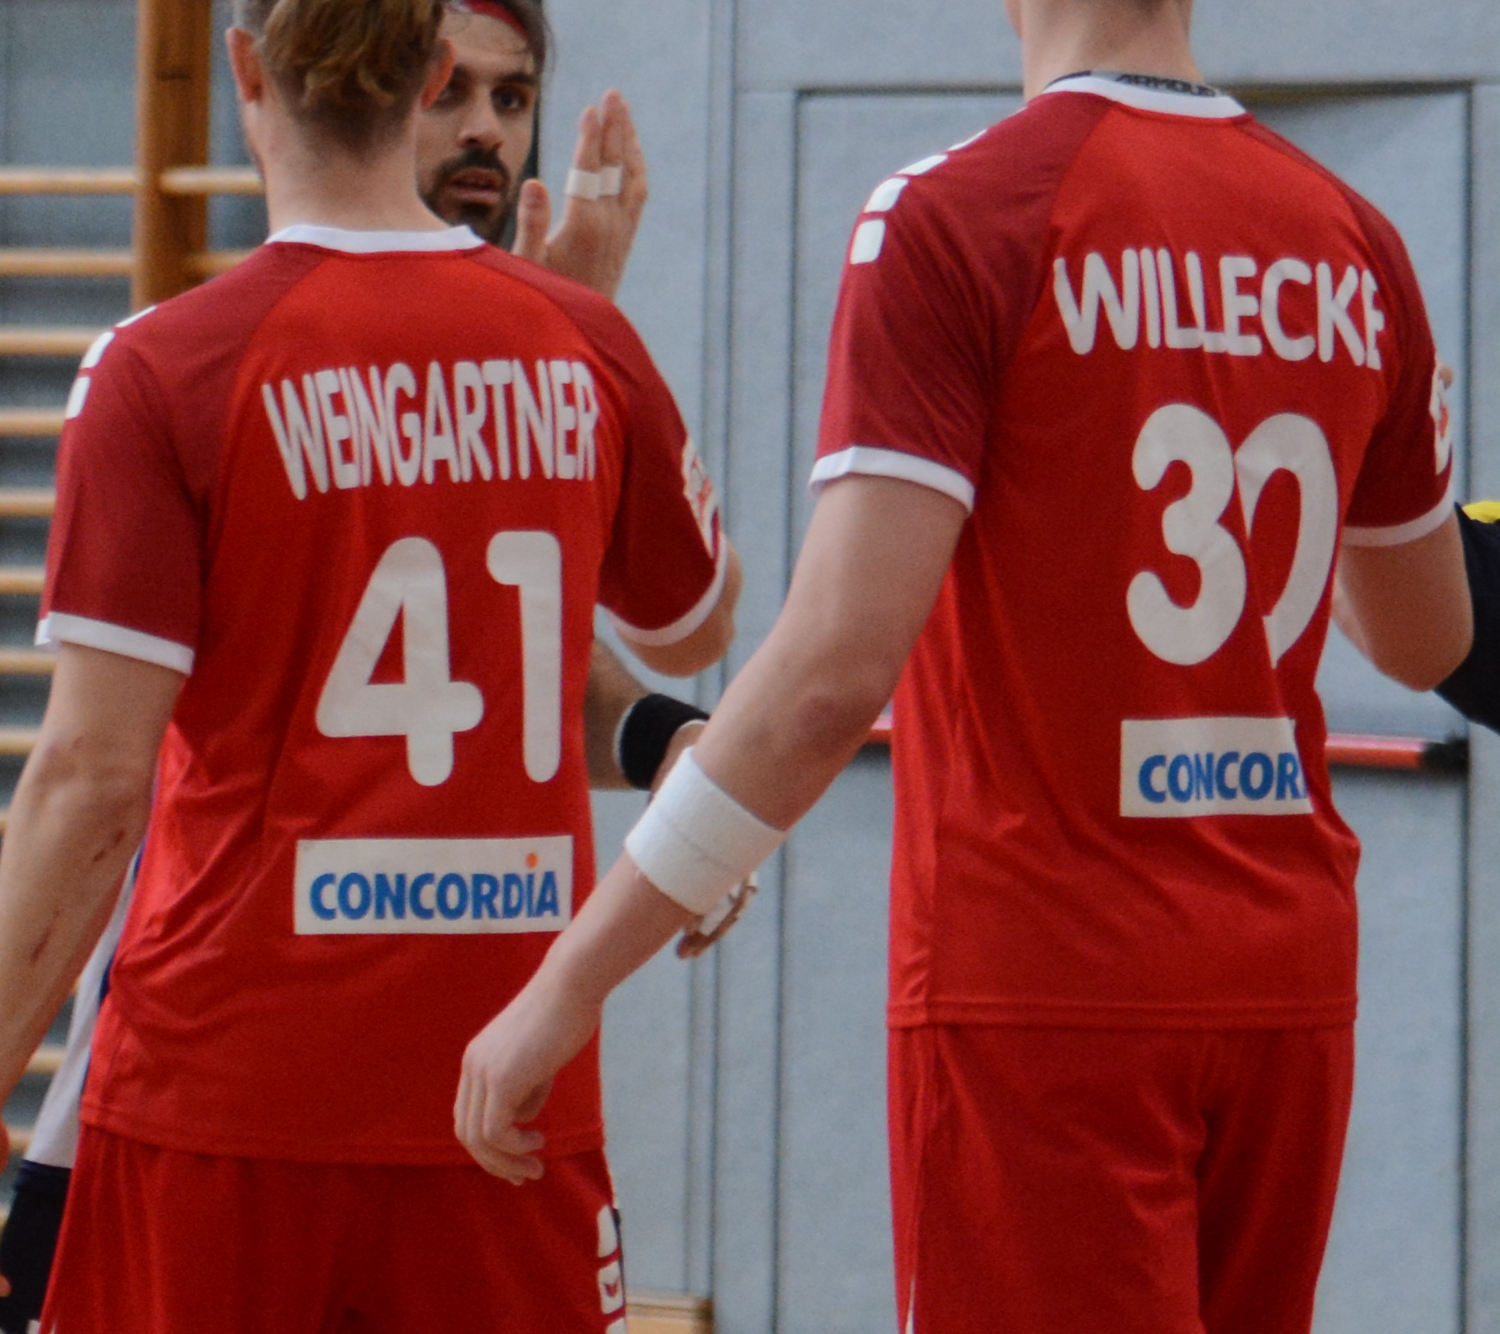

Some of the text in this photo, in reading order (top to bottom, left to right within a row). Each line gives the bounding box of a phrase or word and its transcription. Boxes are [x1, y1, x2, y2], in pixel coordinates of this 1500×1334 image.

[316, 530, 563, 787] 41
[1138, 751, 1308, 804] CONCOR
[310, 852, 560, 920] CONCORDIA
